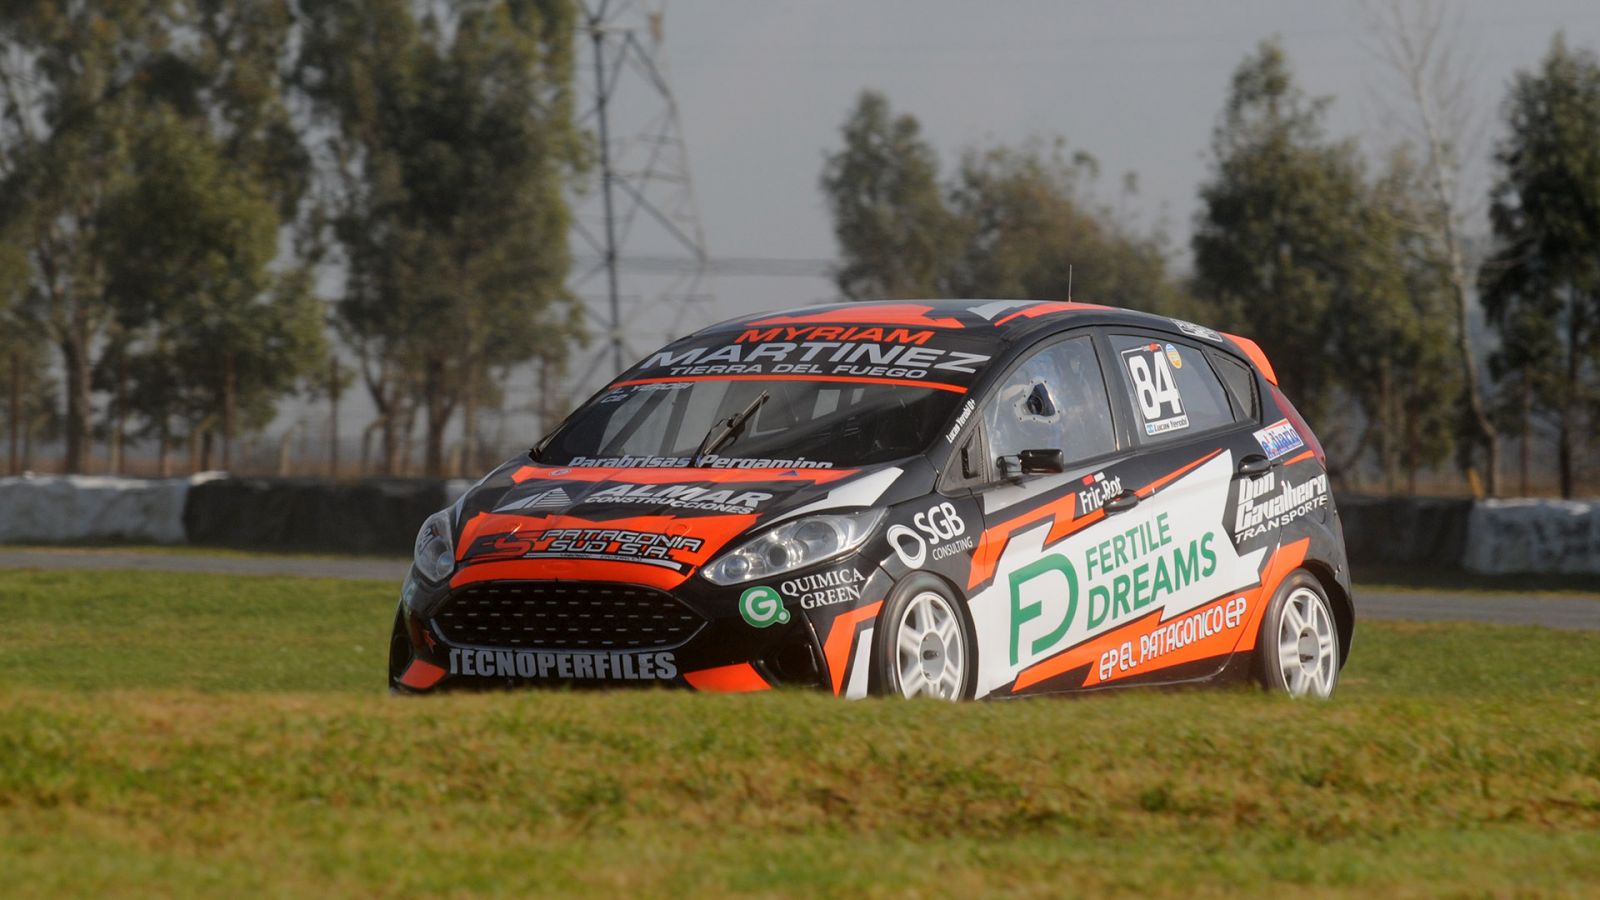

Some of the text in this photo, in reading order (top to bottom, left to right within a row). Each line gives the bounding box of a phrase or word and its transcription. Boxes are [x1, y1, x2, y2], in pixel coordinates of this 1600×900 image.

[734, 327, 936, 345] MYRIAM
[640, 342, 993, 374] MARTINEZ
[670, 363, 928, 378] TIERRA DEL FUEGO
[1128, 351, 1182, 420] 84
[568, 454, 692, 468] Parabrisas
[596, 484, 774, 508] ALMAR
[1239, 472, 1275, 504] Don
[584, 496, 755, 514] CONSTRUCCIONES
[1235, 494, 1328, 545] TRANSPORTE
[913, 502, 966, 545] SGB
[540, 529, 702, 553] PATAGONIA
[547, 540, 606, 553] SUD
[617, 541, 670, 559] S.A.
[932, 536, 973, 561] CONSULTING
[1086, 511, 1173, 581] FERTILE
[781, 567, 866, 598] QUIMICA
[1087, 531, 1217, 632] DREAMS
[800, 585, 861, 610] GREEN
[1119, 641, 1137, 671] EL
[1139, 605, 1223, 664] PATAGONICO
[449, 648, 678, 680] TECNOPERFILES
